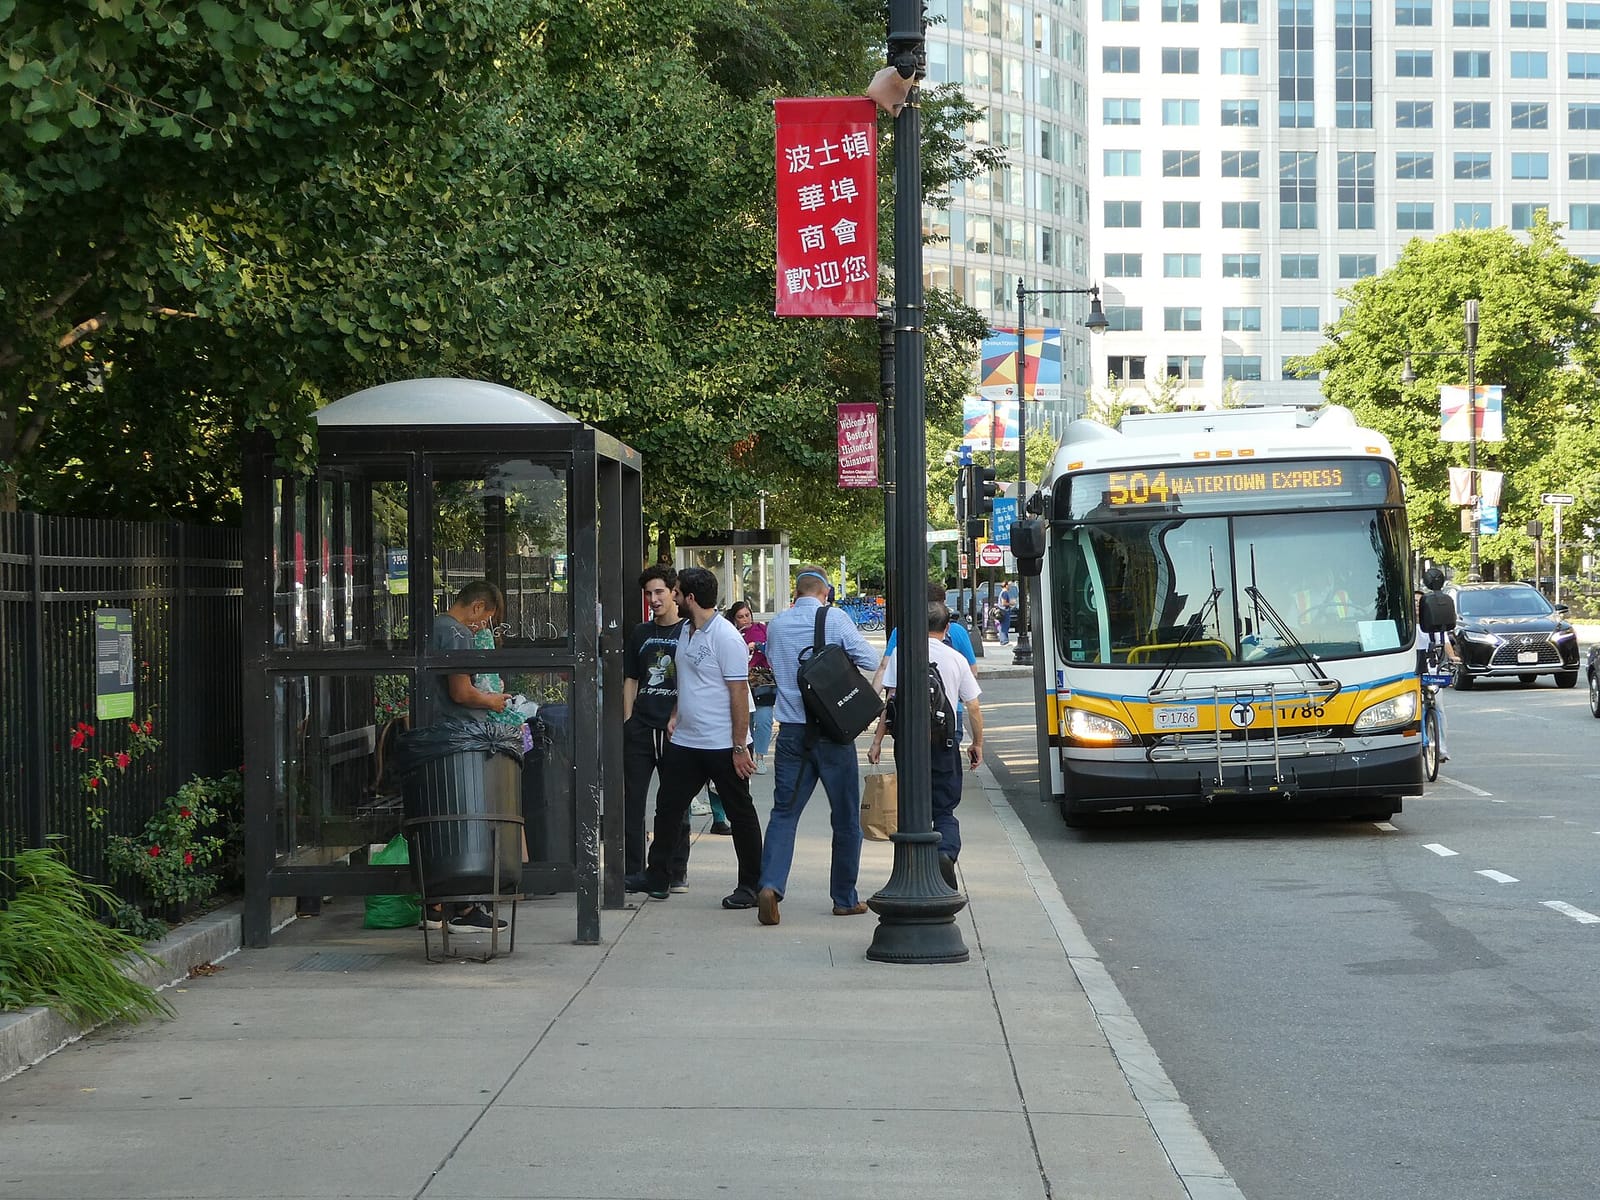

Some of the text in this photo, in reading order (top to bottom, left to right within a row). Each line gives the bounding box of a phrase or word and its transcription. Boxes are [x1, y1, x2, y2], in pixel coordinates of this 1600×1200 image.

[784, 131, 871, 174] 波士頓
[797, 177, 859, 212] 華埠
[798, 217, 858, 253] 商會
[784, 255, 870, 295] 歡迎您
[840, 418, 866, 429] Welcome
[840, 454, 875, 468] Chinatown
[841, 440, 874, 455] Historical
[1108, 468, 1343, 505] 504 WATERTOWN EXPRESS
[1170, 711, 1196, 724] 1786
